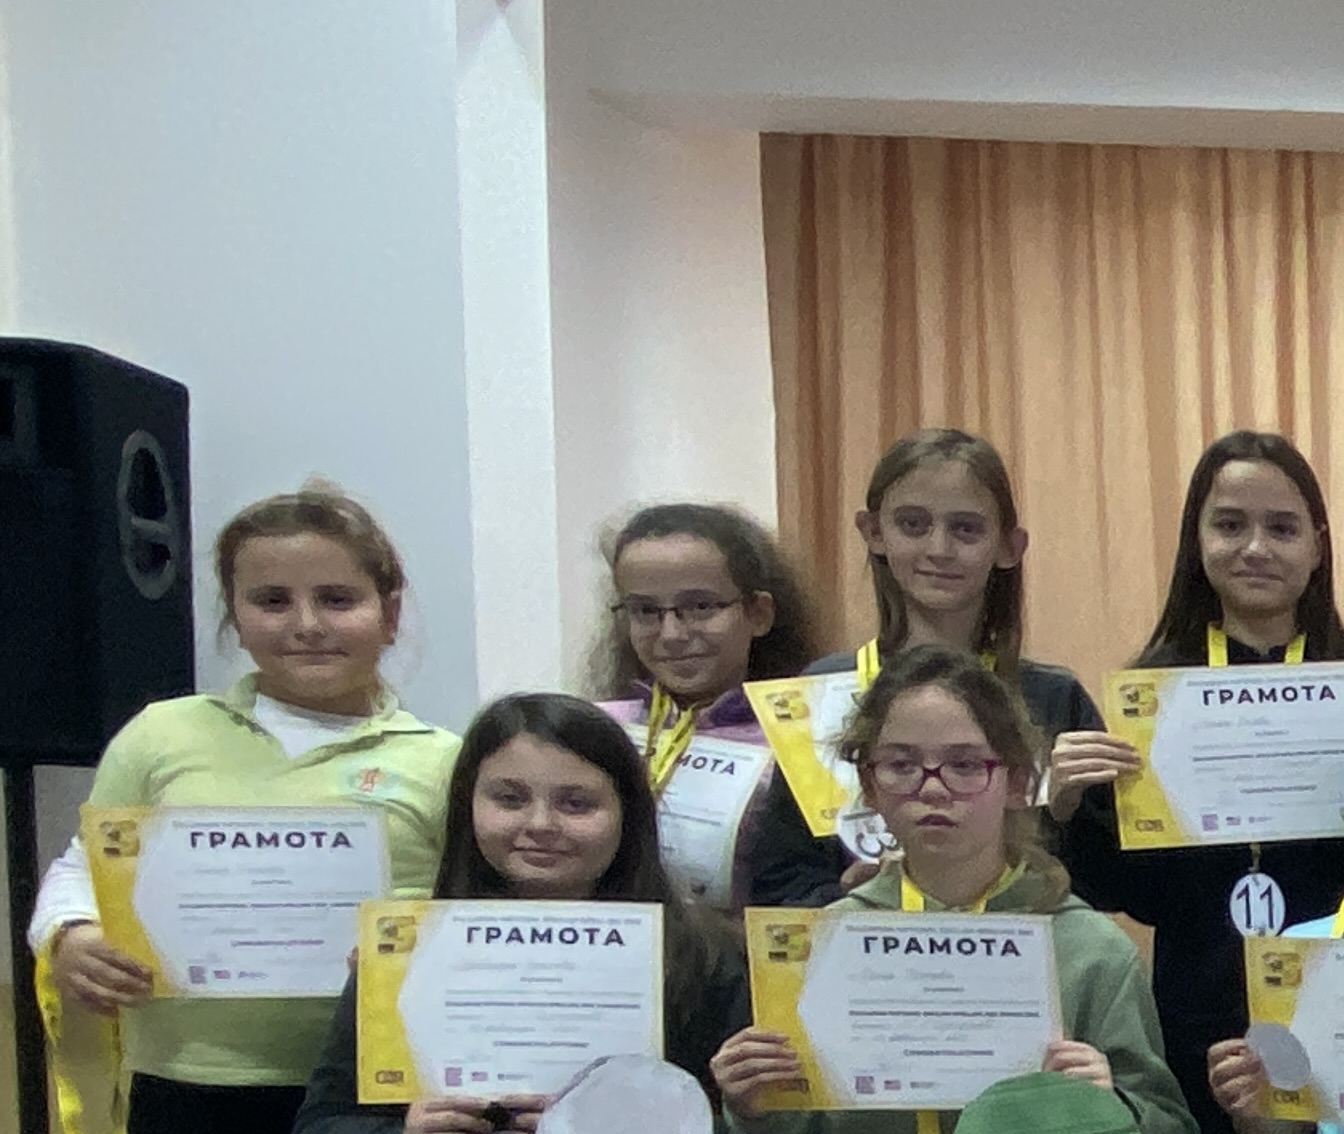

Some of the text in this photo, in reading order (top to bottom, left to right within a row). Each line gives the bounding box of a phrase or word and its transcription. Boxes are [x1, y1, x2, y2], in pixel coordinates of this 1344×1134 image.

[1202, 685, 1336, 706] ГРАМОТА
[190, 832, 352, 848] ГРАМОТА
[1236, 883, 1276, 930] 11
[467, 927, 625, 946] ГРАМОТА
[864, 937, 1021, 957] ГРАМОТА
